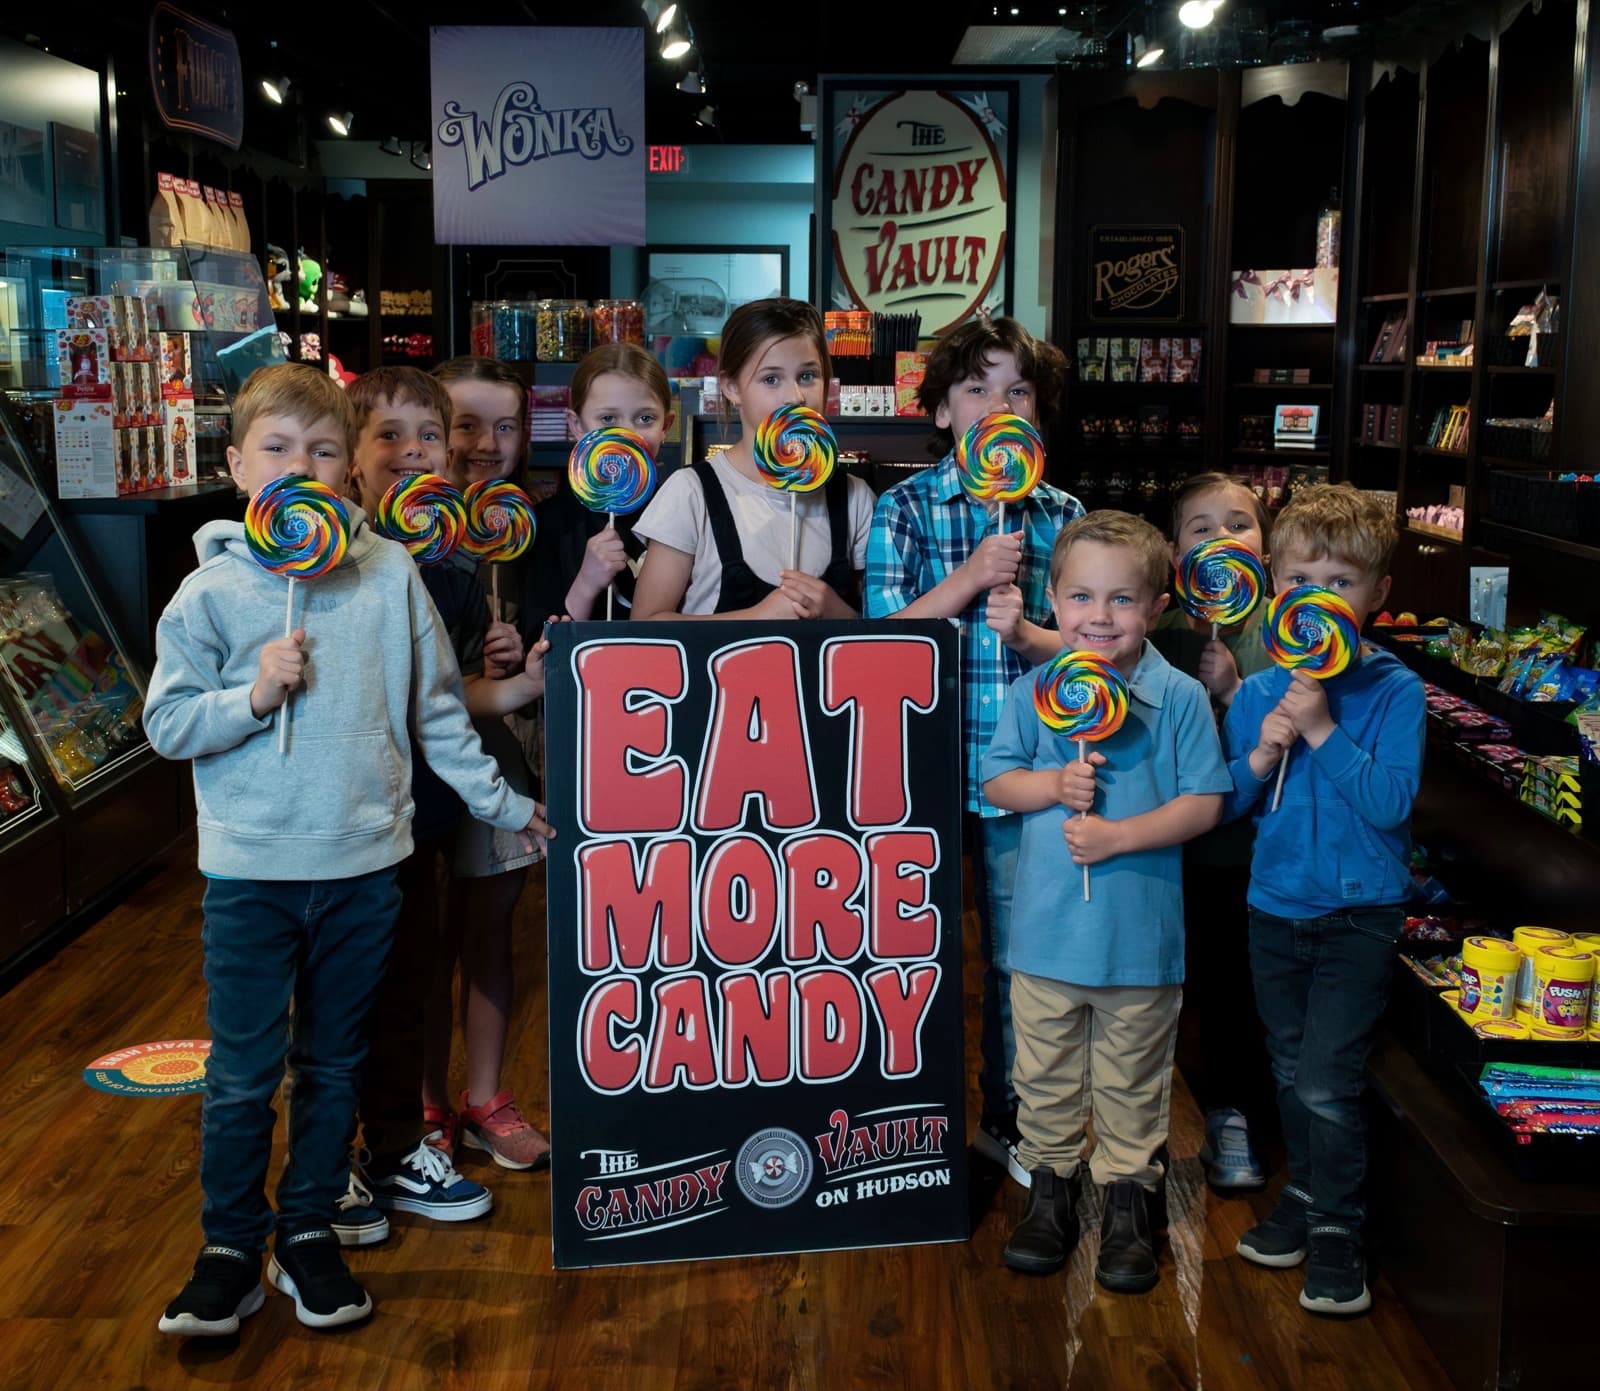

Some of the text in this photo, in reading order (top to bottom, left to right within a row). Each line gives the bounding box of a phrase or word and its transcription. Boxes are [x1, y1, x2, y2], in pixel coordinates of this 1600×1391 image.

[438, 81, 634, 191] WONKA
[649, 145, 682, 172] EXIT
[897, 121, 946, 146] THE
[851, 158, 988, 216] CANDY
[865, 221, 987, 294] VAULT
[571, 635, 941, 839] EAT
[574, 826, 942, 976] MORE
[1549, 986, 1581, 998] PUSH
[146, 1042, 194, 1052] WAIT
[576, 962, 942, 1096] CANDY
[579, 1148, 639, 1174] THE
[815, 1108, 949, 1175] VAULT
[574, 1160, 732, 1231] CANDY
[815, 1168, 951, 1208] ON HUDSON
